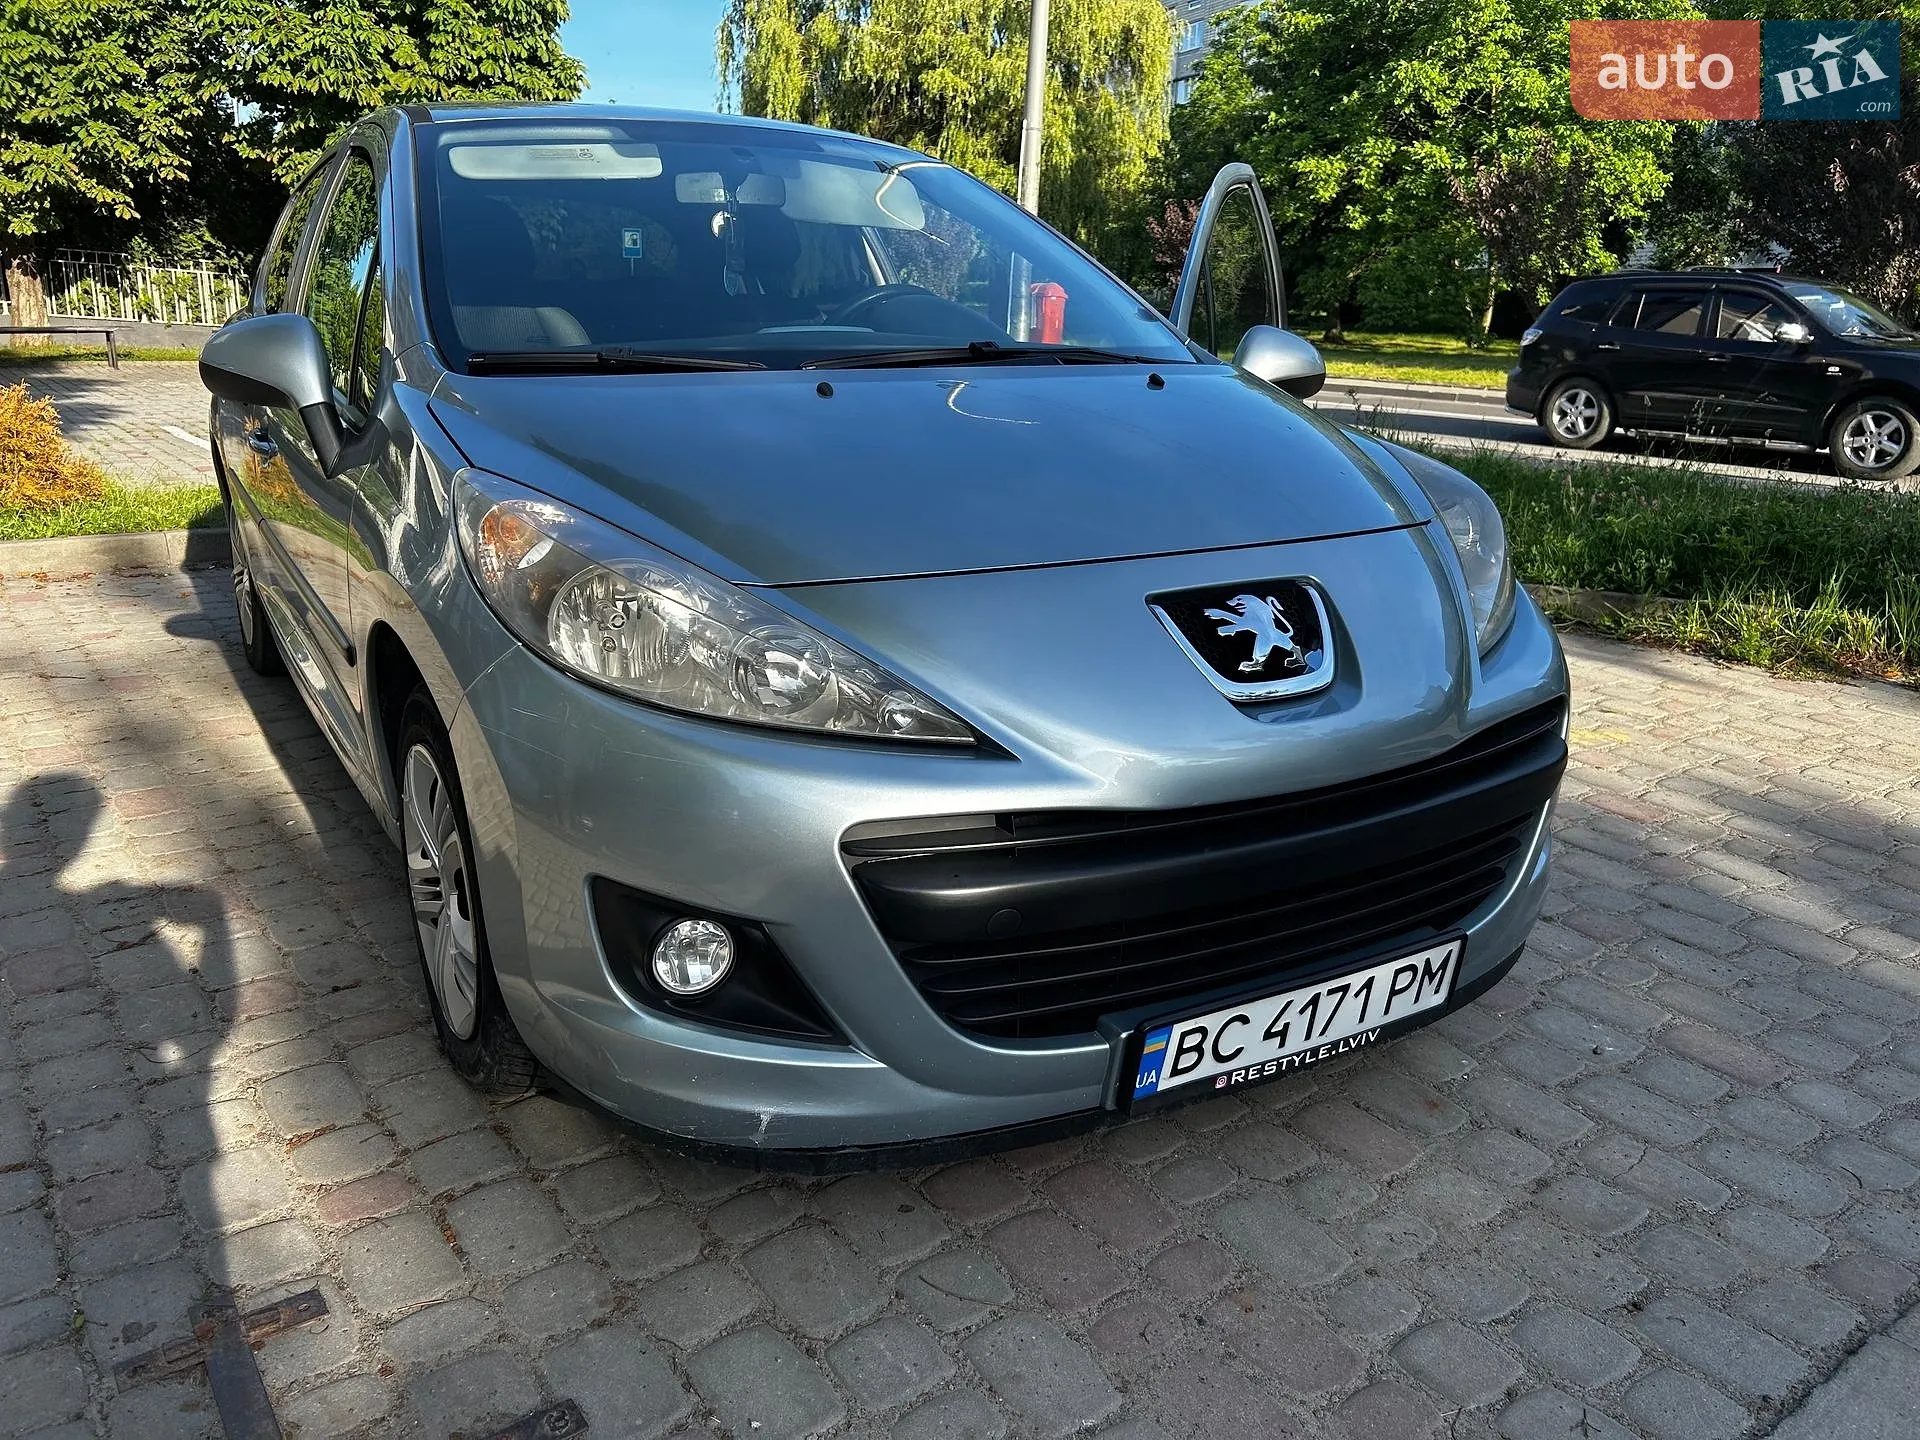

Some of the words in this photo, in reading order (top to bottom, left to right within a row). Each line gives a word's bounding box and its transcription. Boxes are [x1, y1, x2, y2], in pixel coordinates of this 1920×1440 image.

[1168, 1013, 1250, 1079] BC
[1261, 975, 1376, 1050] 4171
[1383, 948, 1454, 1017] PM
[1135, 1069, 1157, 1089] UA
[1230, 1028, 1381, 1085] RESTYLE.LVIV
